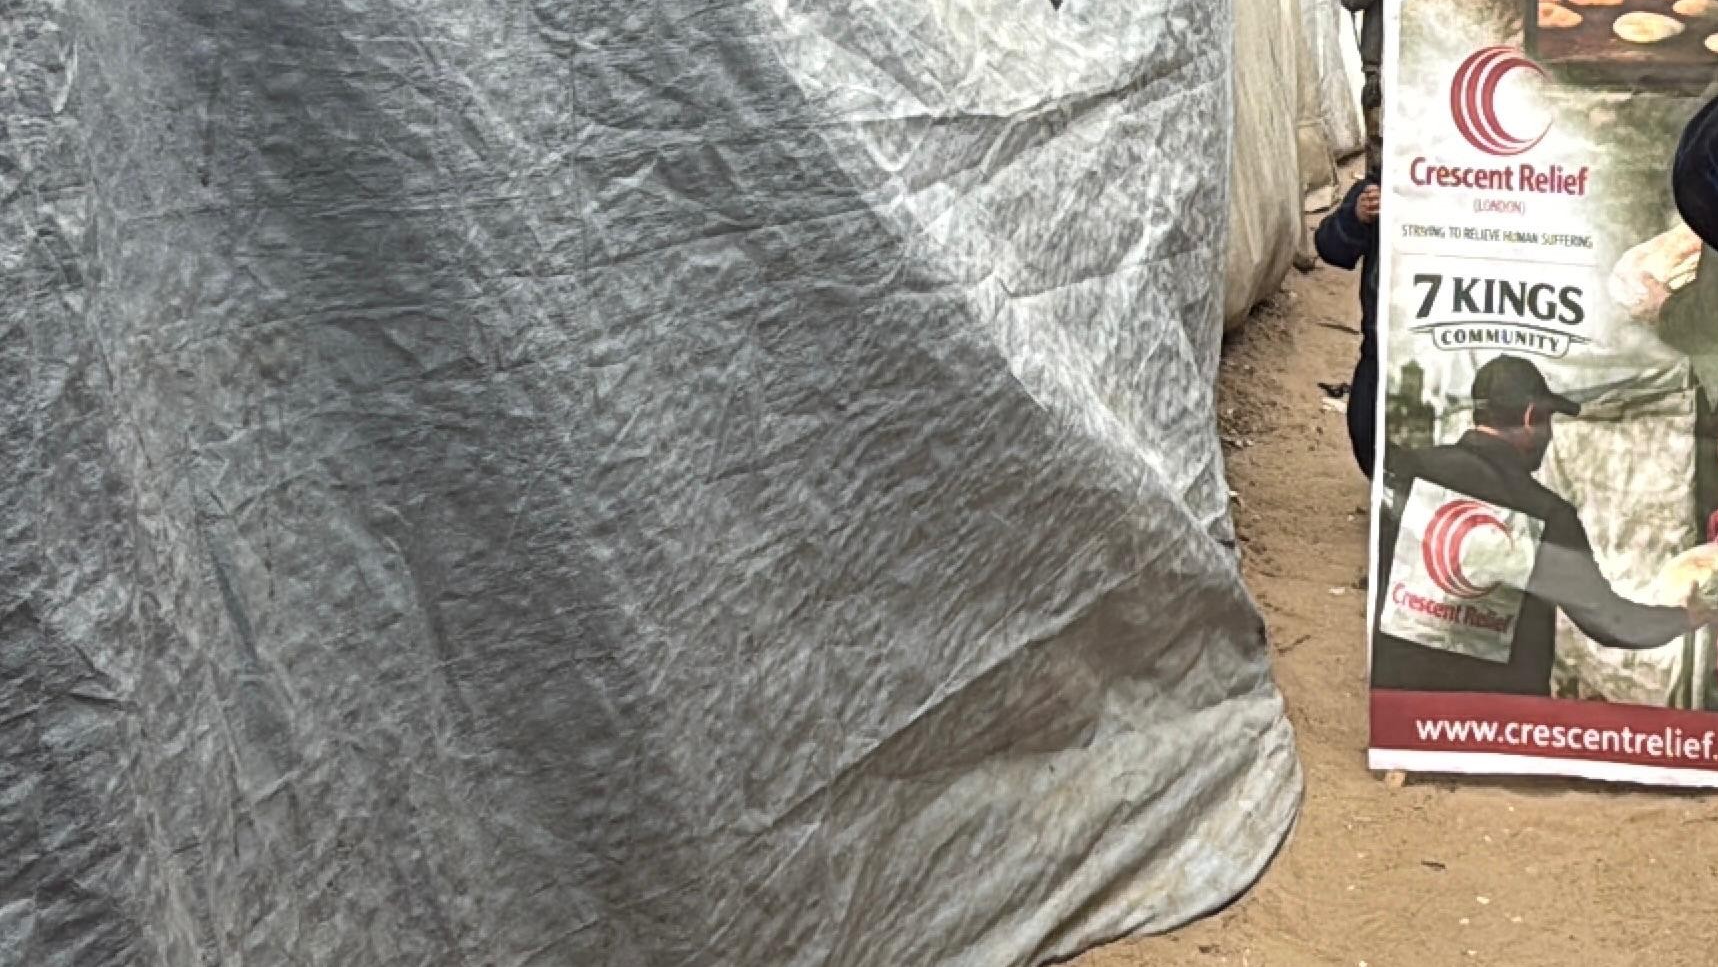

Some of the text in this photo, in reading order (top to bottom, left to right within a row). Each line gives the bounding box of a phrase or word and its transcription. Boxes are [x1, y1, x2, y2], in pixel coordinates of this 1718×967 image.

[1410, 157, 1589, 196] Crescent Relief
[1413, 274, 1584, 326] 7 KINGS
[1441, 328, 1560, 352] COMMUNITY
